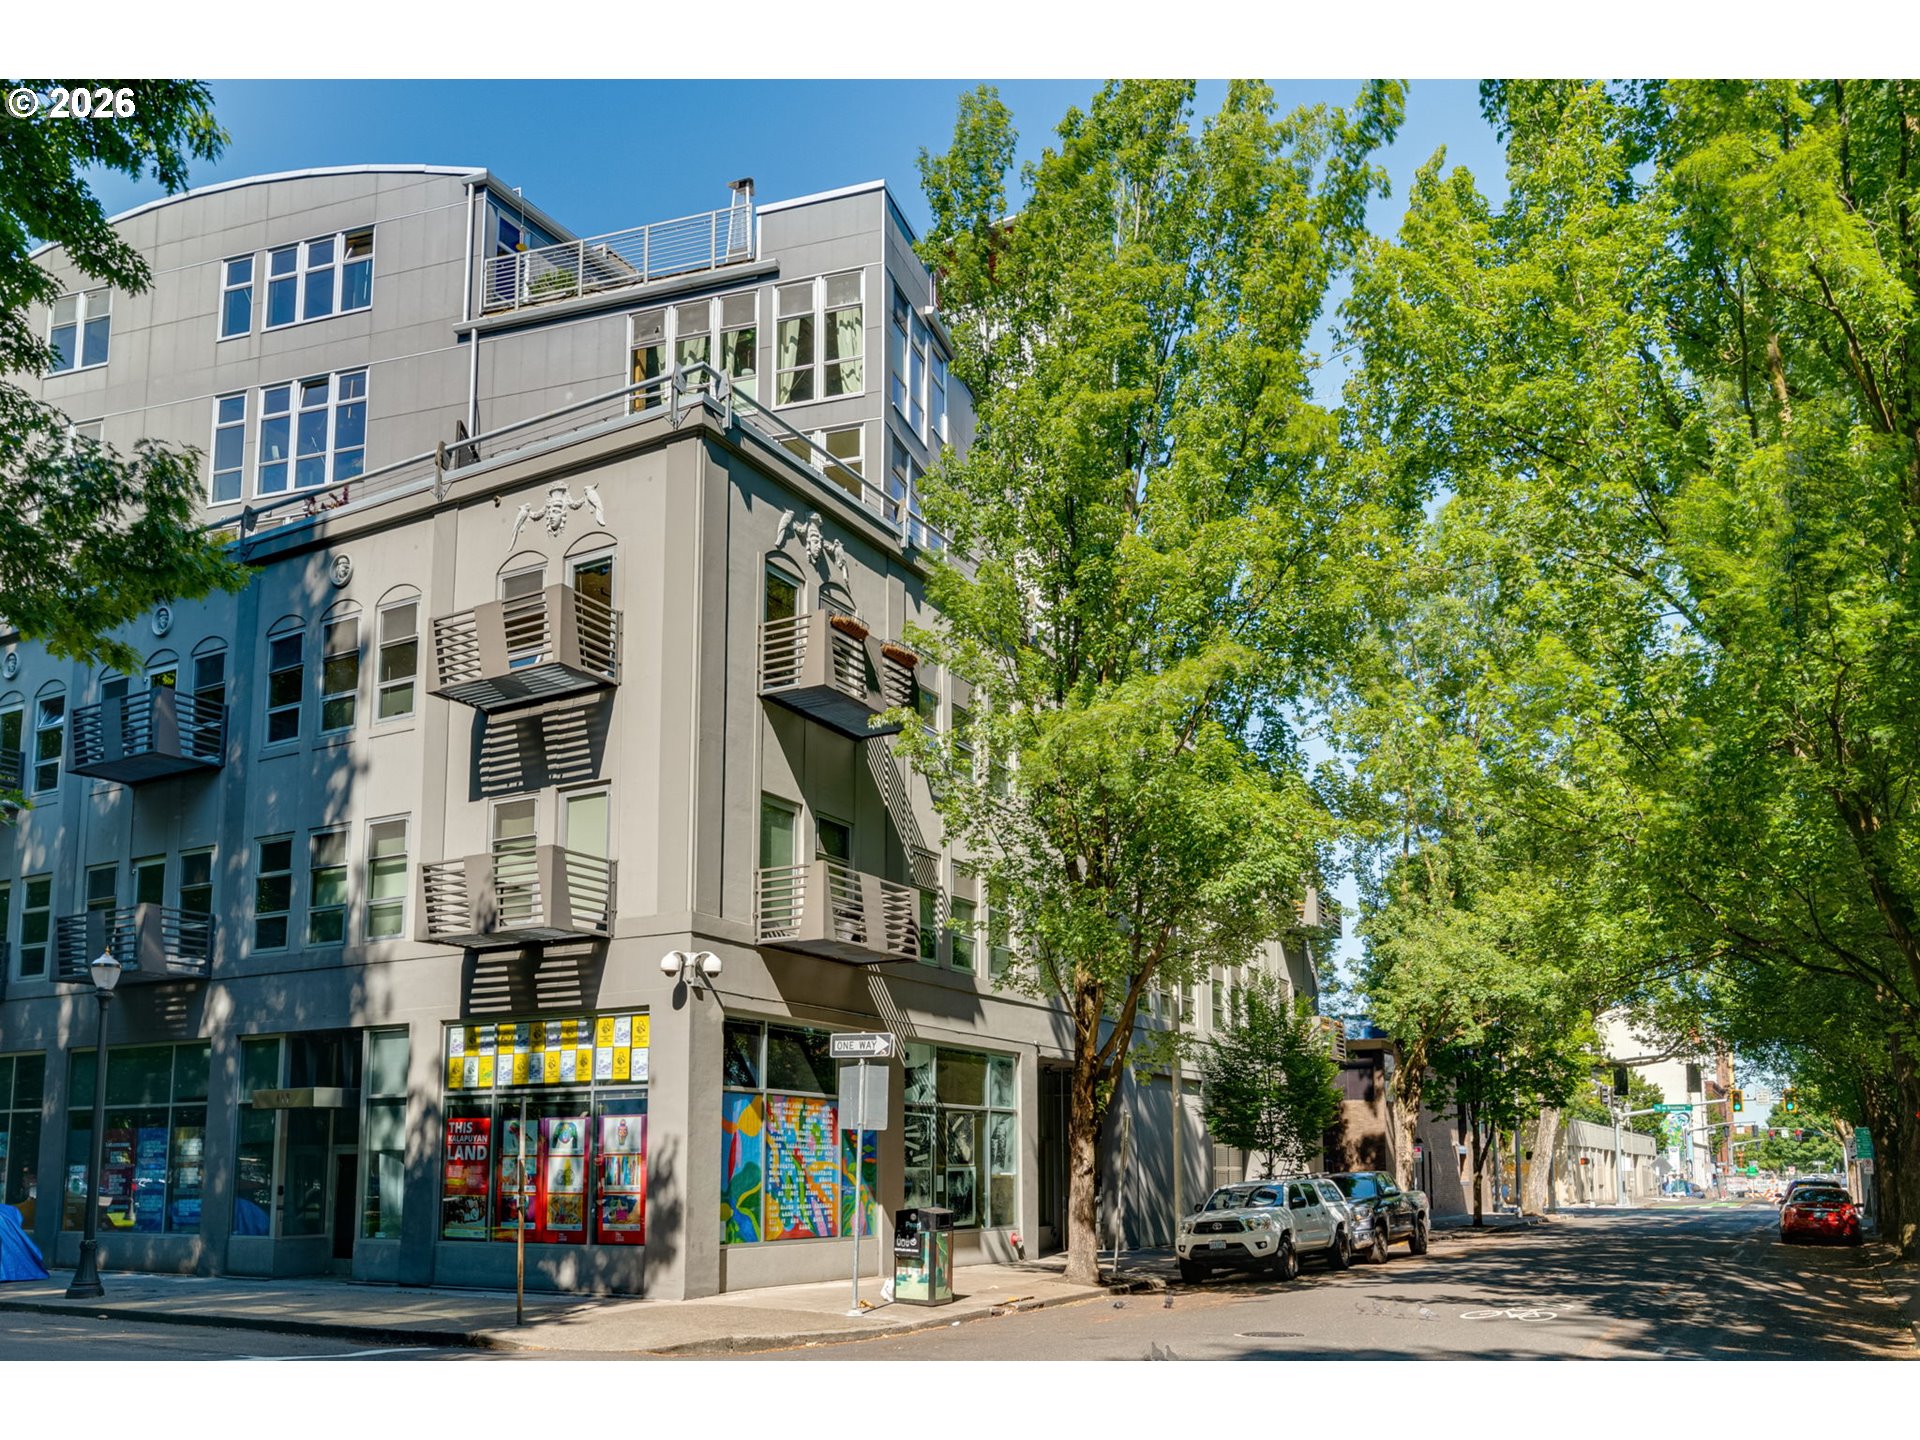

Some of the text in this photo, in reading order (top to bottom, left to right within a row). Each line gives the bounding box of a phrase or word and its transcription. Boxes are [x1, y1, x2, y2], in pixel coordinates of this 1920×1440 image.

[836, 1040, 877, 1050] ONE WAY
[448, 1121, 473, 1134] THIS
[447, 1145, 488, 1161] LAND
